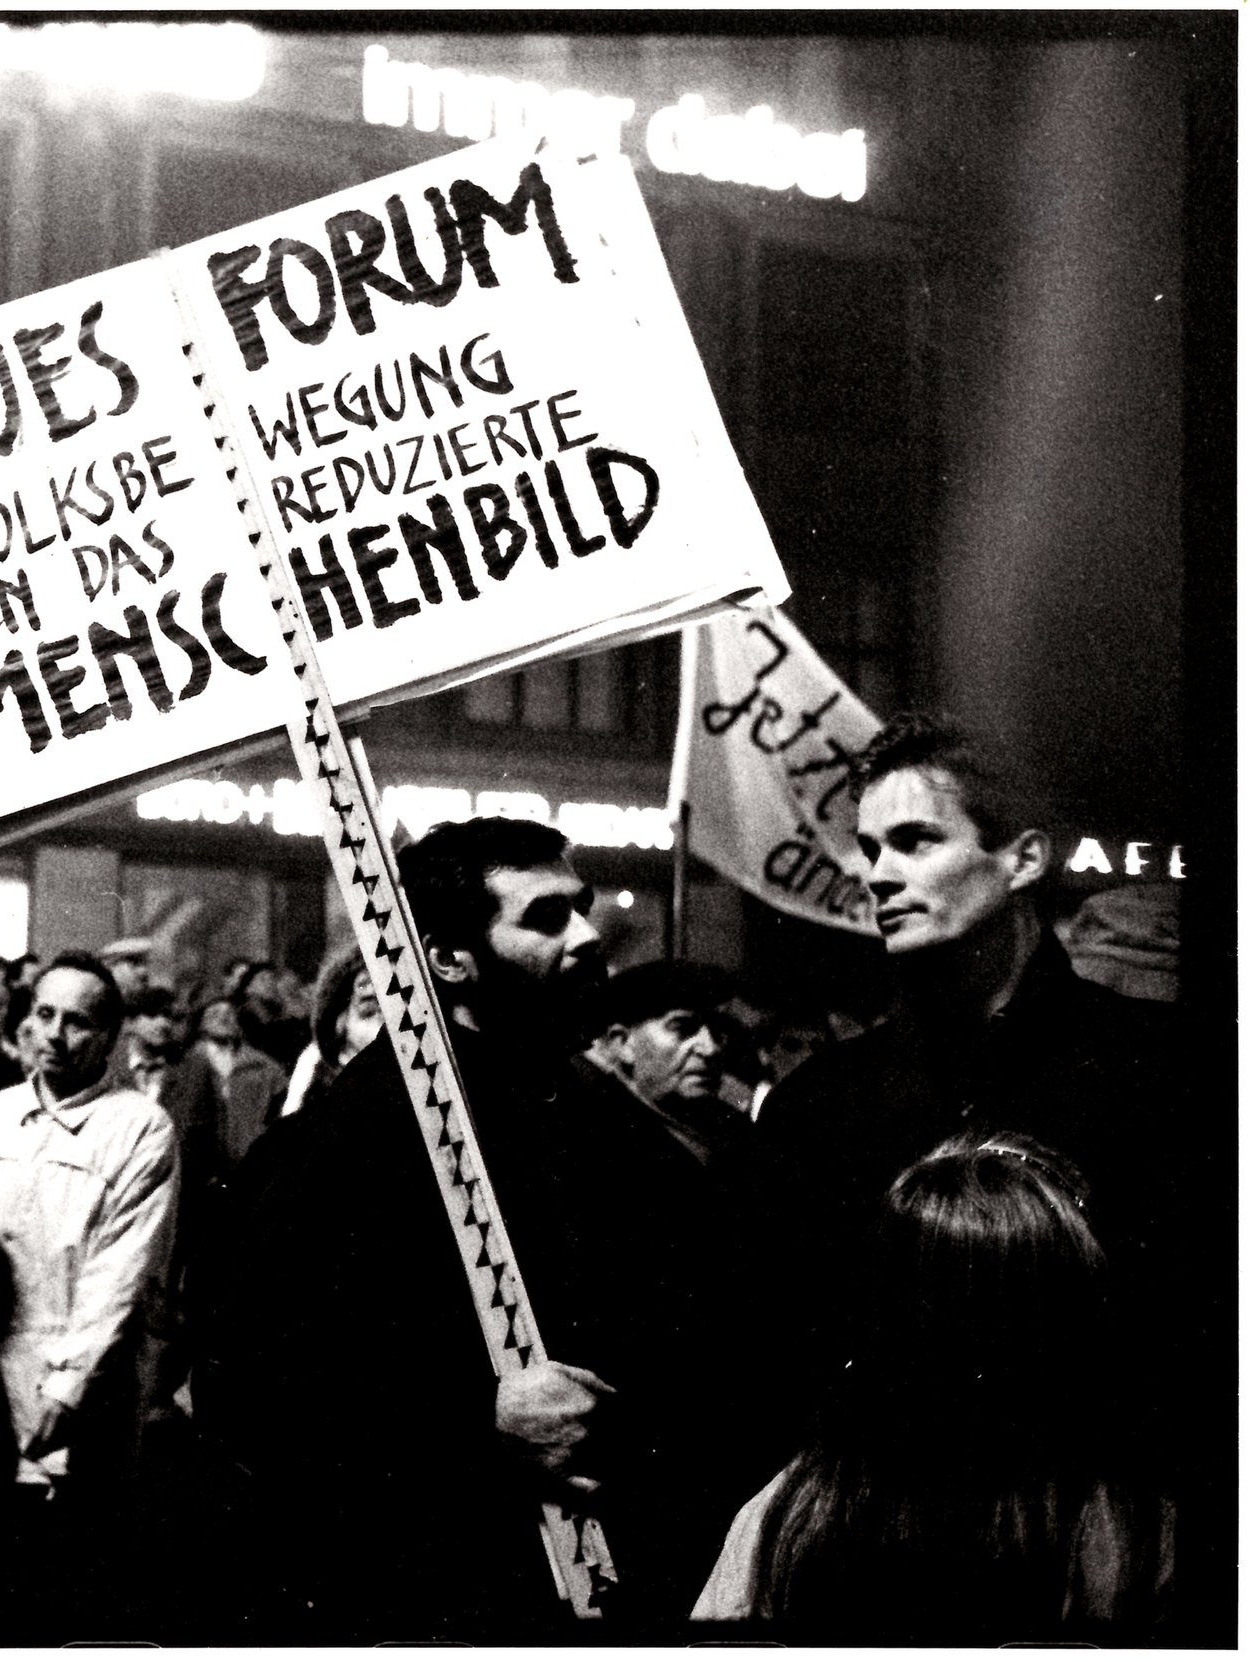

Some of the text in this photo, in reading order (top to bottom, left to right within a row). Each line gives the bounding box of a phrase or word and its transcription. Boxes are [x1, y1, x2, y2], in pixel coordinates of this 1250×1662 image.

[207, 163, 580, 371] FORUM
[72, 520, 174, 602] DAS
[272, 390, 598, 532] REDUZIERTE
[248, 333, 514, 460] WEGUNG
[289, 447, 659, 642] HENBILD
